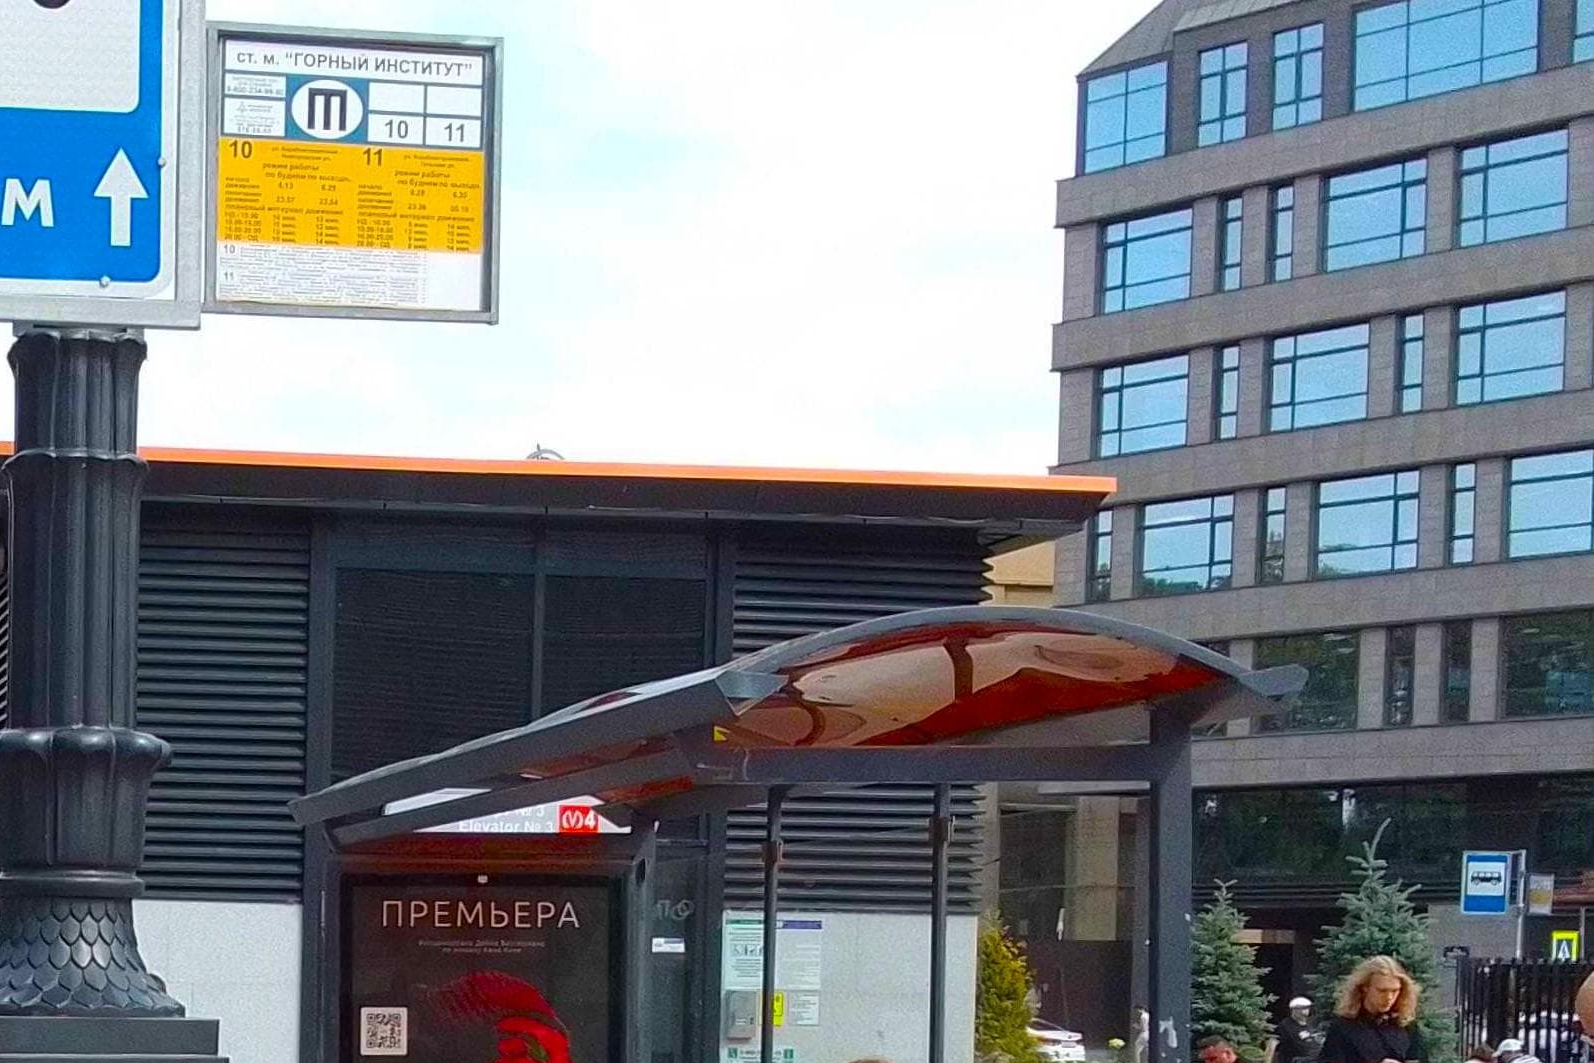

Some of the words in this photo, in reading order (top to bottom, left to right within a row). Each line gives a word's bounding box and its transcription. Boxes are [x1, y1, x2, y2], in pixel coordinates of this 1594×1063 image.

[237, 51, 257, 64] ст.
[263, 53, 280, 66] м.
[286, 51, 369, 71] "ГОРНЫЙ
[375, 57, 472, 77] ИНСТИТУТ"
[384, 119, 409, 139] 10
[443, 122, 466, 143] 11
[229, 139, 253, 159] 10
[362, 147, 383, 167] 11
[458, 820, 519, 833] Elevator
[381, 900, 580, 929] ПРЕМЬЕРА
